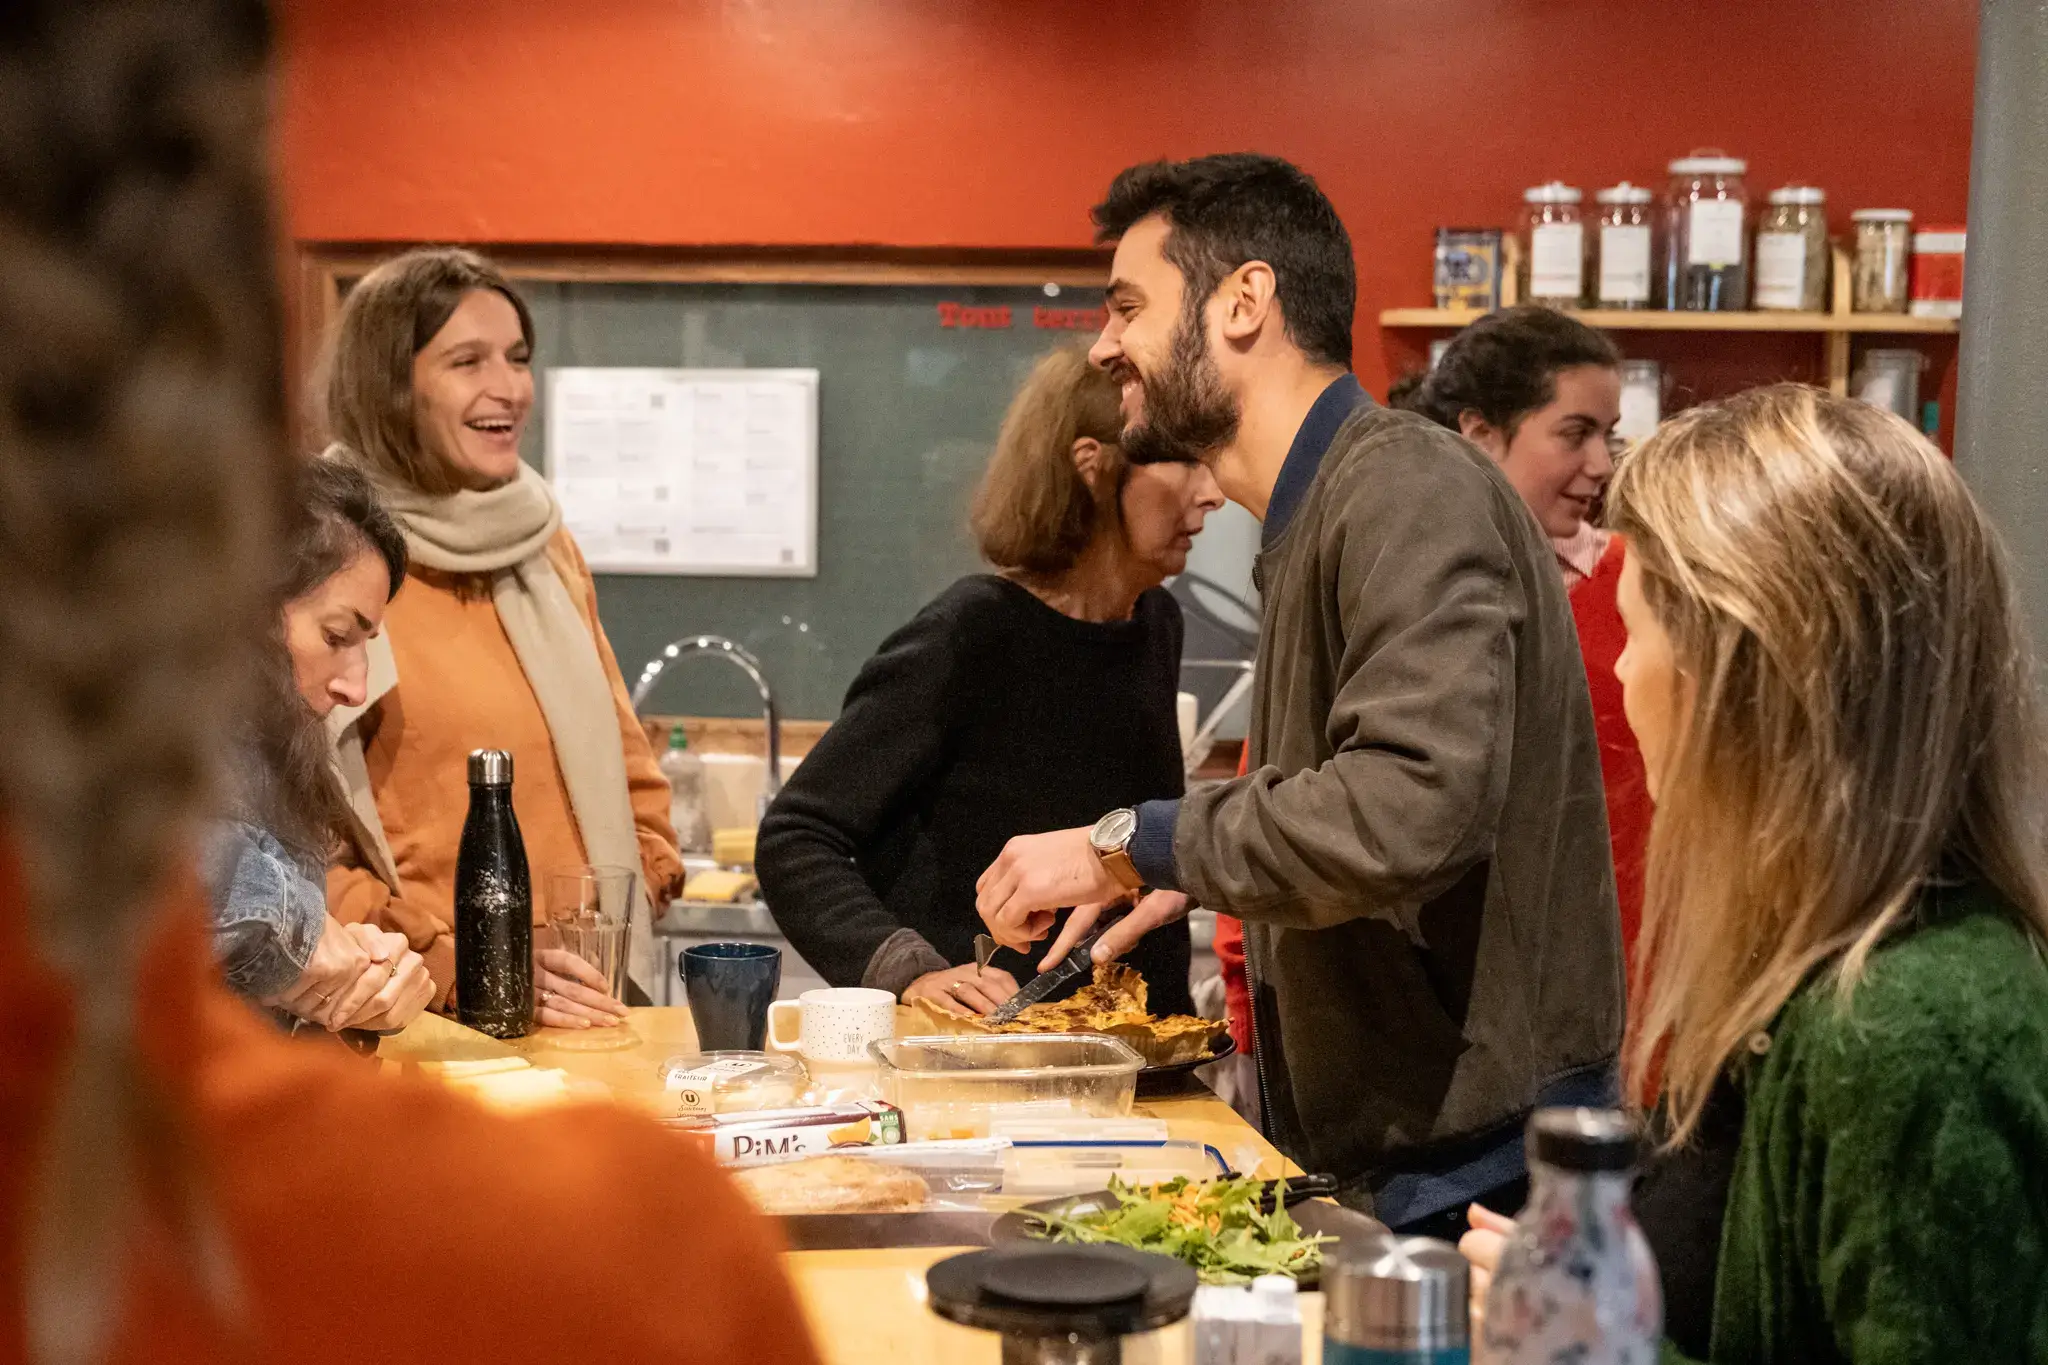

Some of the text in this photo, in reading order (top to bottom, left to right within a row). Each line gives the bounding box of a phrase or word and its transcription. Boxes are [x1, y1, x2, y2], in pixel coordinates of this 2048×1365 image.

[843, 1032, 864, 1044] EVERY
[847, 1044, 860, 1055] DAY
[685, 1094, 695, 1103] U
